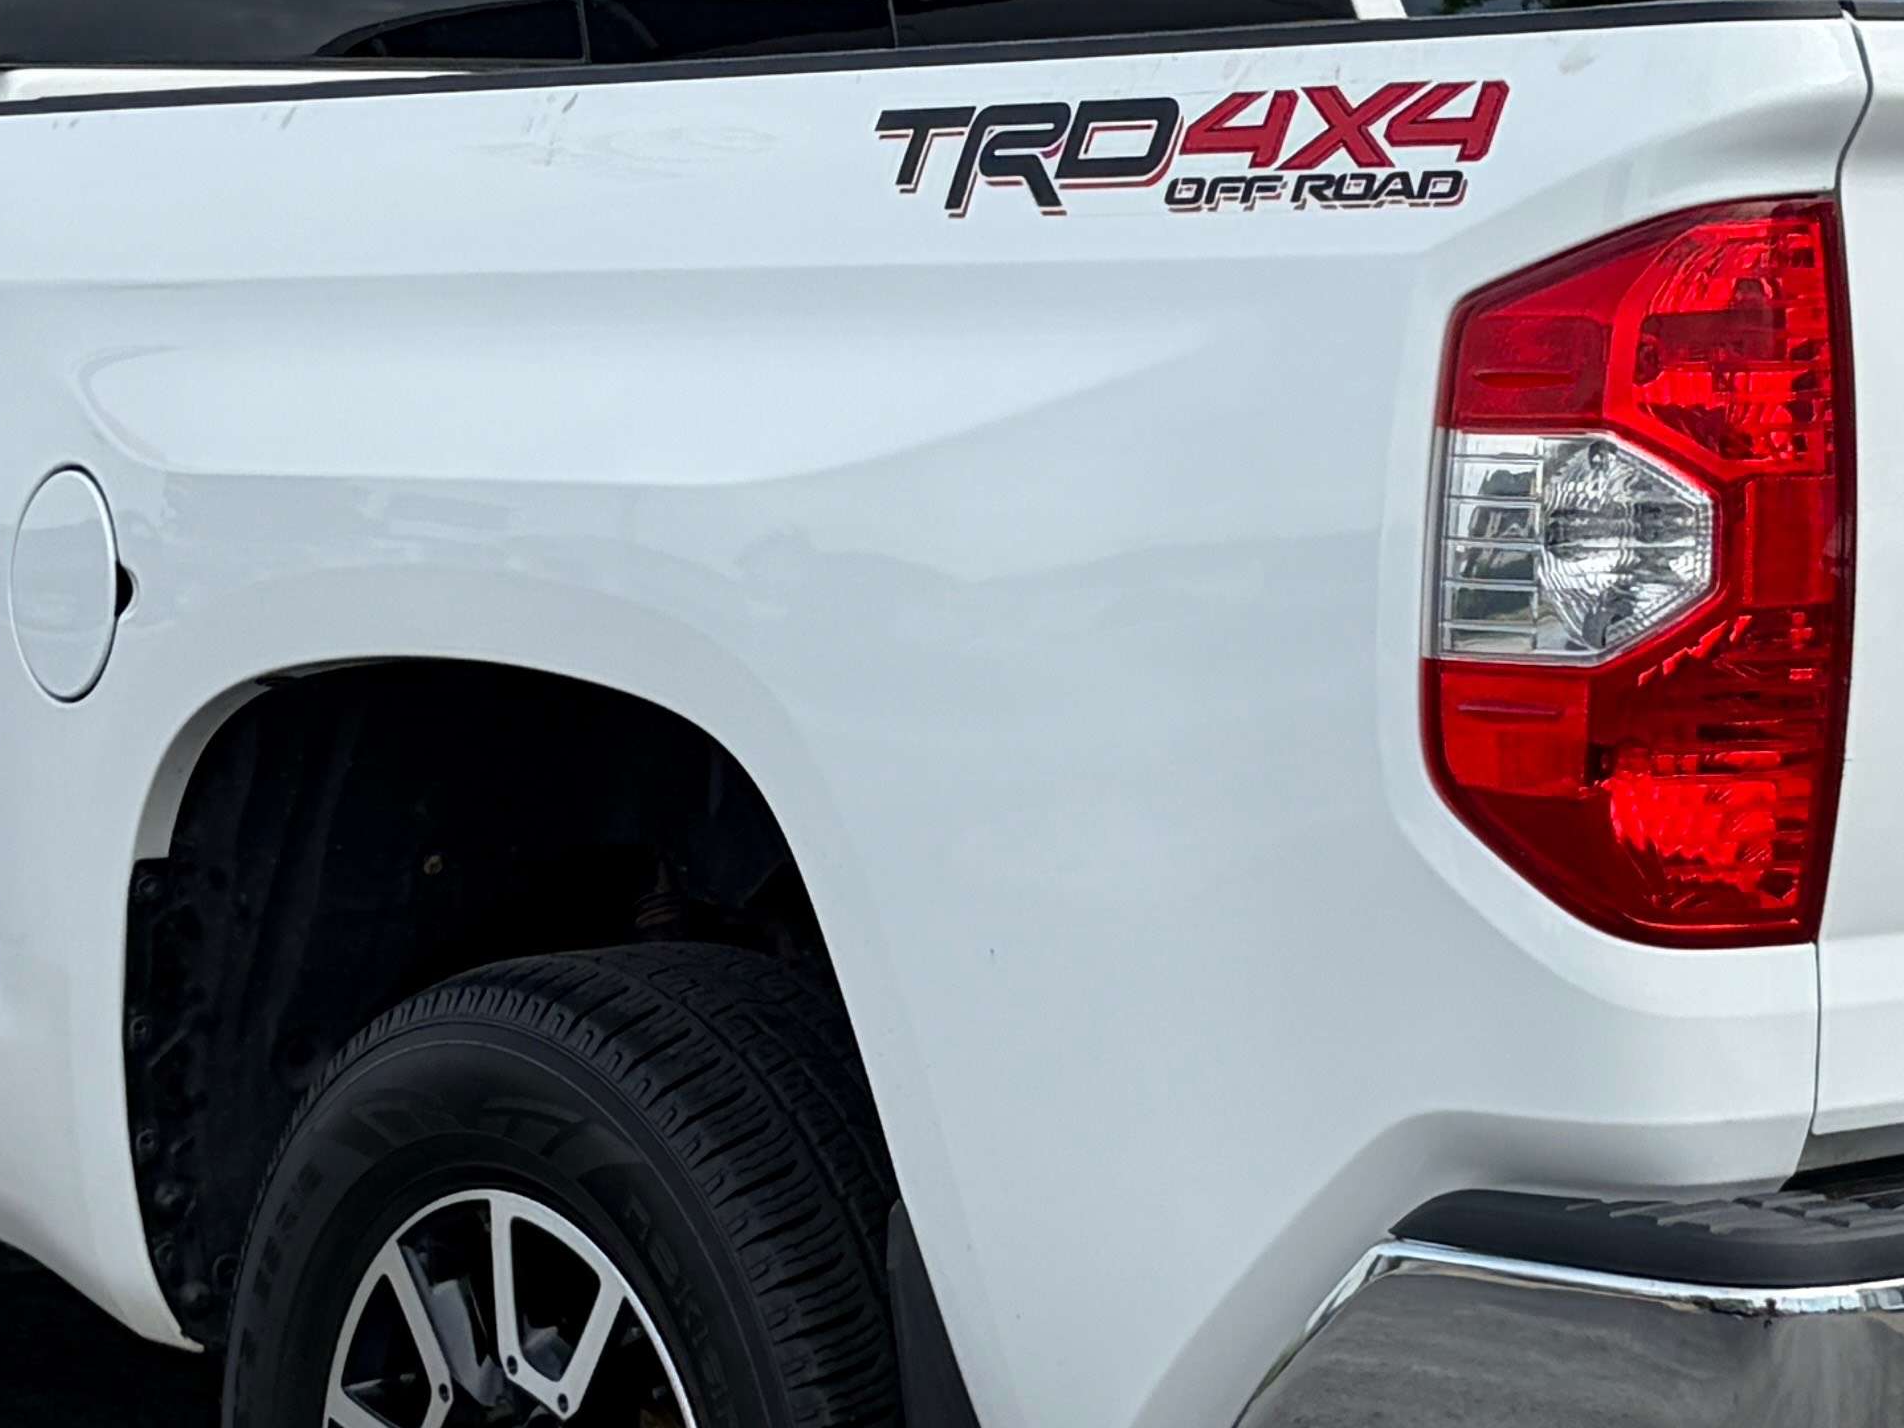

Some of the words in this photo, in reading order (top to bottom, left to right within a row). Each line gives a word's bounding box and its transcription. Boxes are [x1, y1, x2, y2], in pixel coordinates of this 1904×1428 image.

[875, 97, 1183, 218] TRD
[1164, 173, 1286, 213] OFF
[1290, 169, 1468, 212] ROAD
